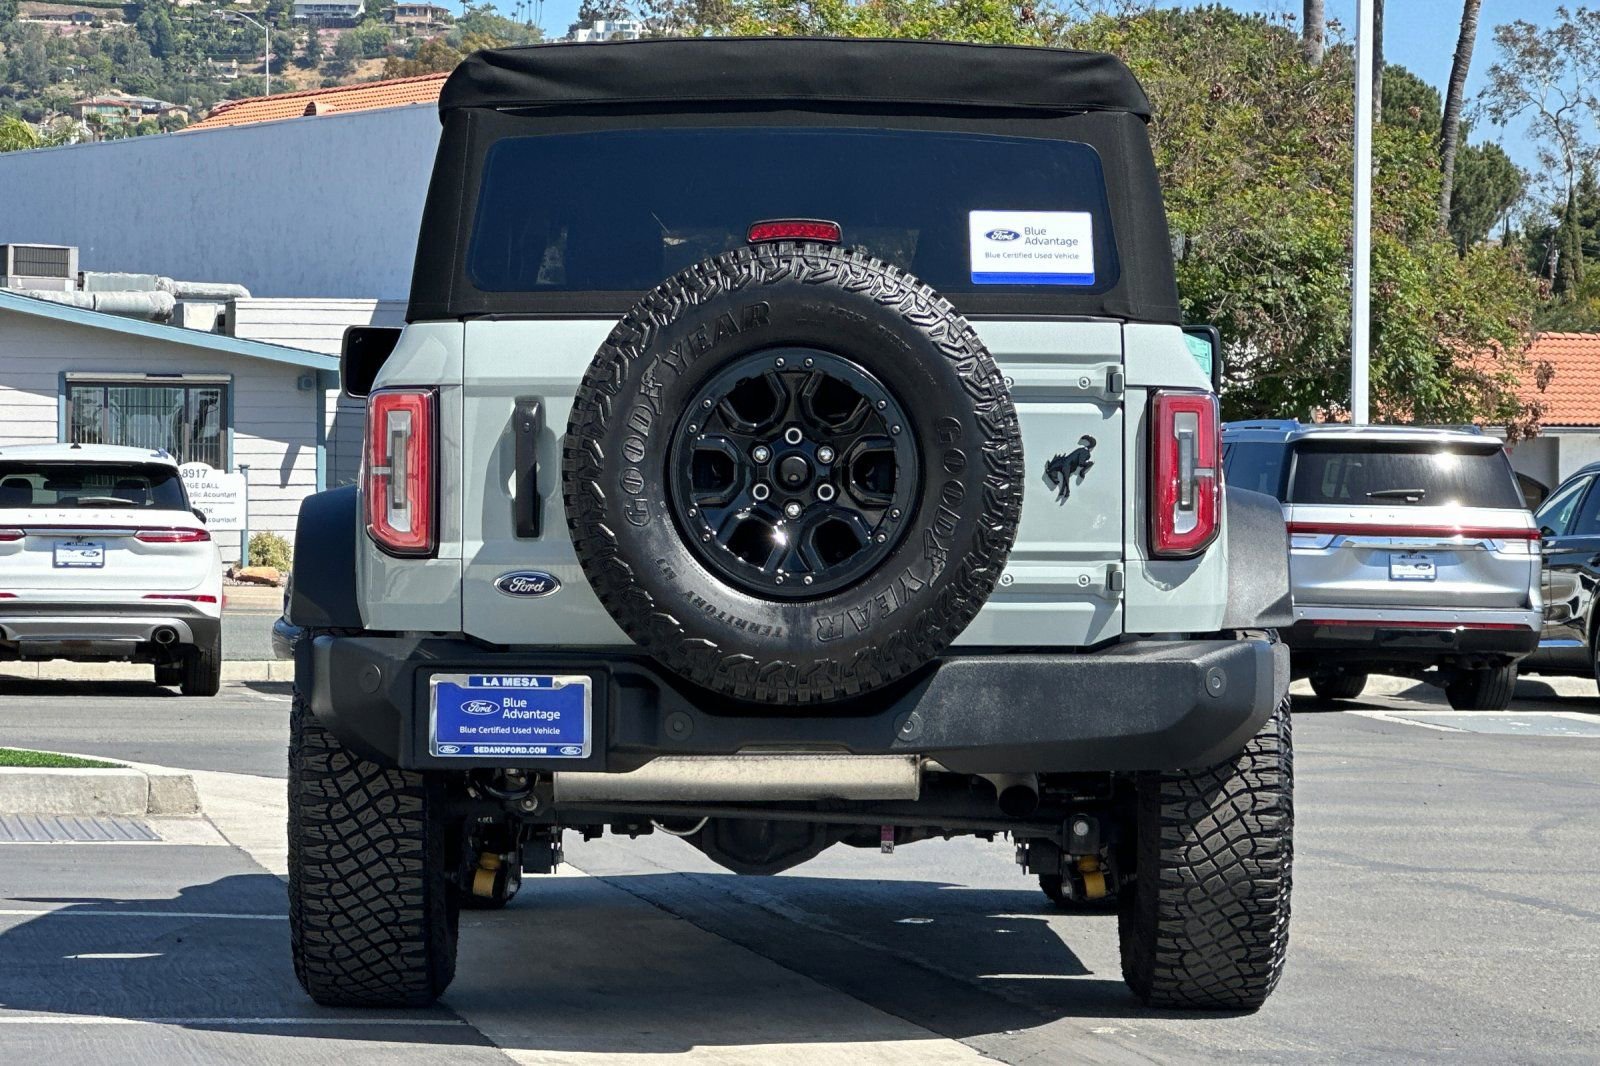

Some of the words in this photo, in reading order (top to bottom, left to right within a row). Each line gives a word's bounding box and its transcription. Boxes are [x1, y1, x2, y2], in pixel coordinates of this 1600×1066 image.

[991, 230, 1015, 241] Ford
[1024, 226, 1047, 236] Blue
[1024, 237, 1079, 247] Advantage
[1054, 252, 1080, 260] Vehicle
[182, 468, 208, 478] 8917
[482, 677, 500, 687] LA
[502, 677, 539, 687] MESA
[467, 702, 493, 713] Ford
[502, 697, 528, 708] Blue
[502, 709, 561, 721] Advantage
[459, 726, 477, 734] Blue
[478, 725, 511, 734] Certified
[512, 726, 532, 735] Used
[534, 726, 561, 735] Vehicle
[473, 746, 547, 755] SEDANOFORD.COM
